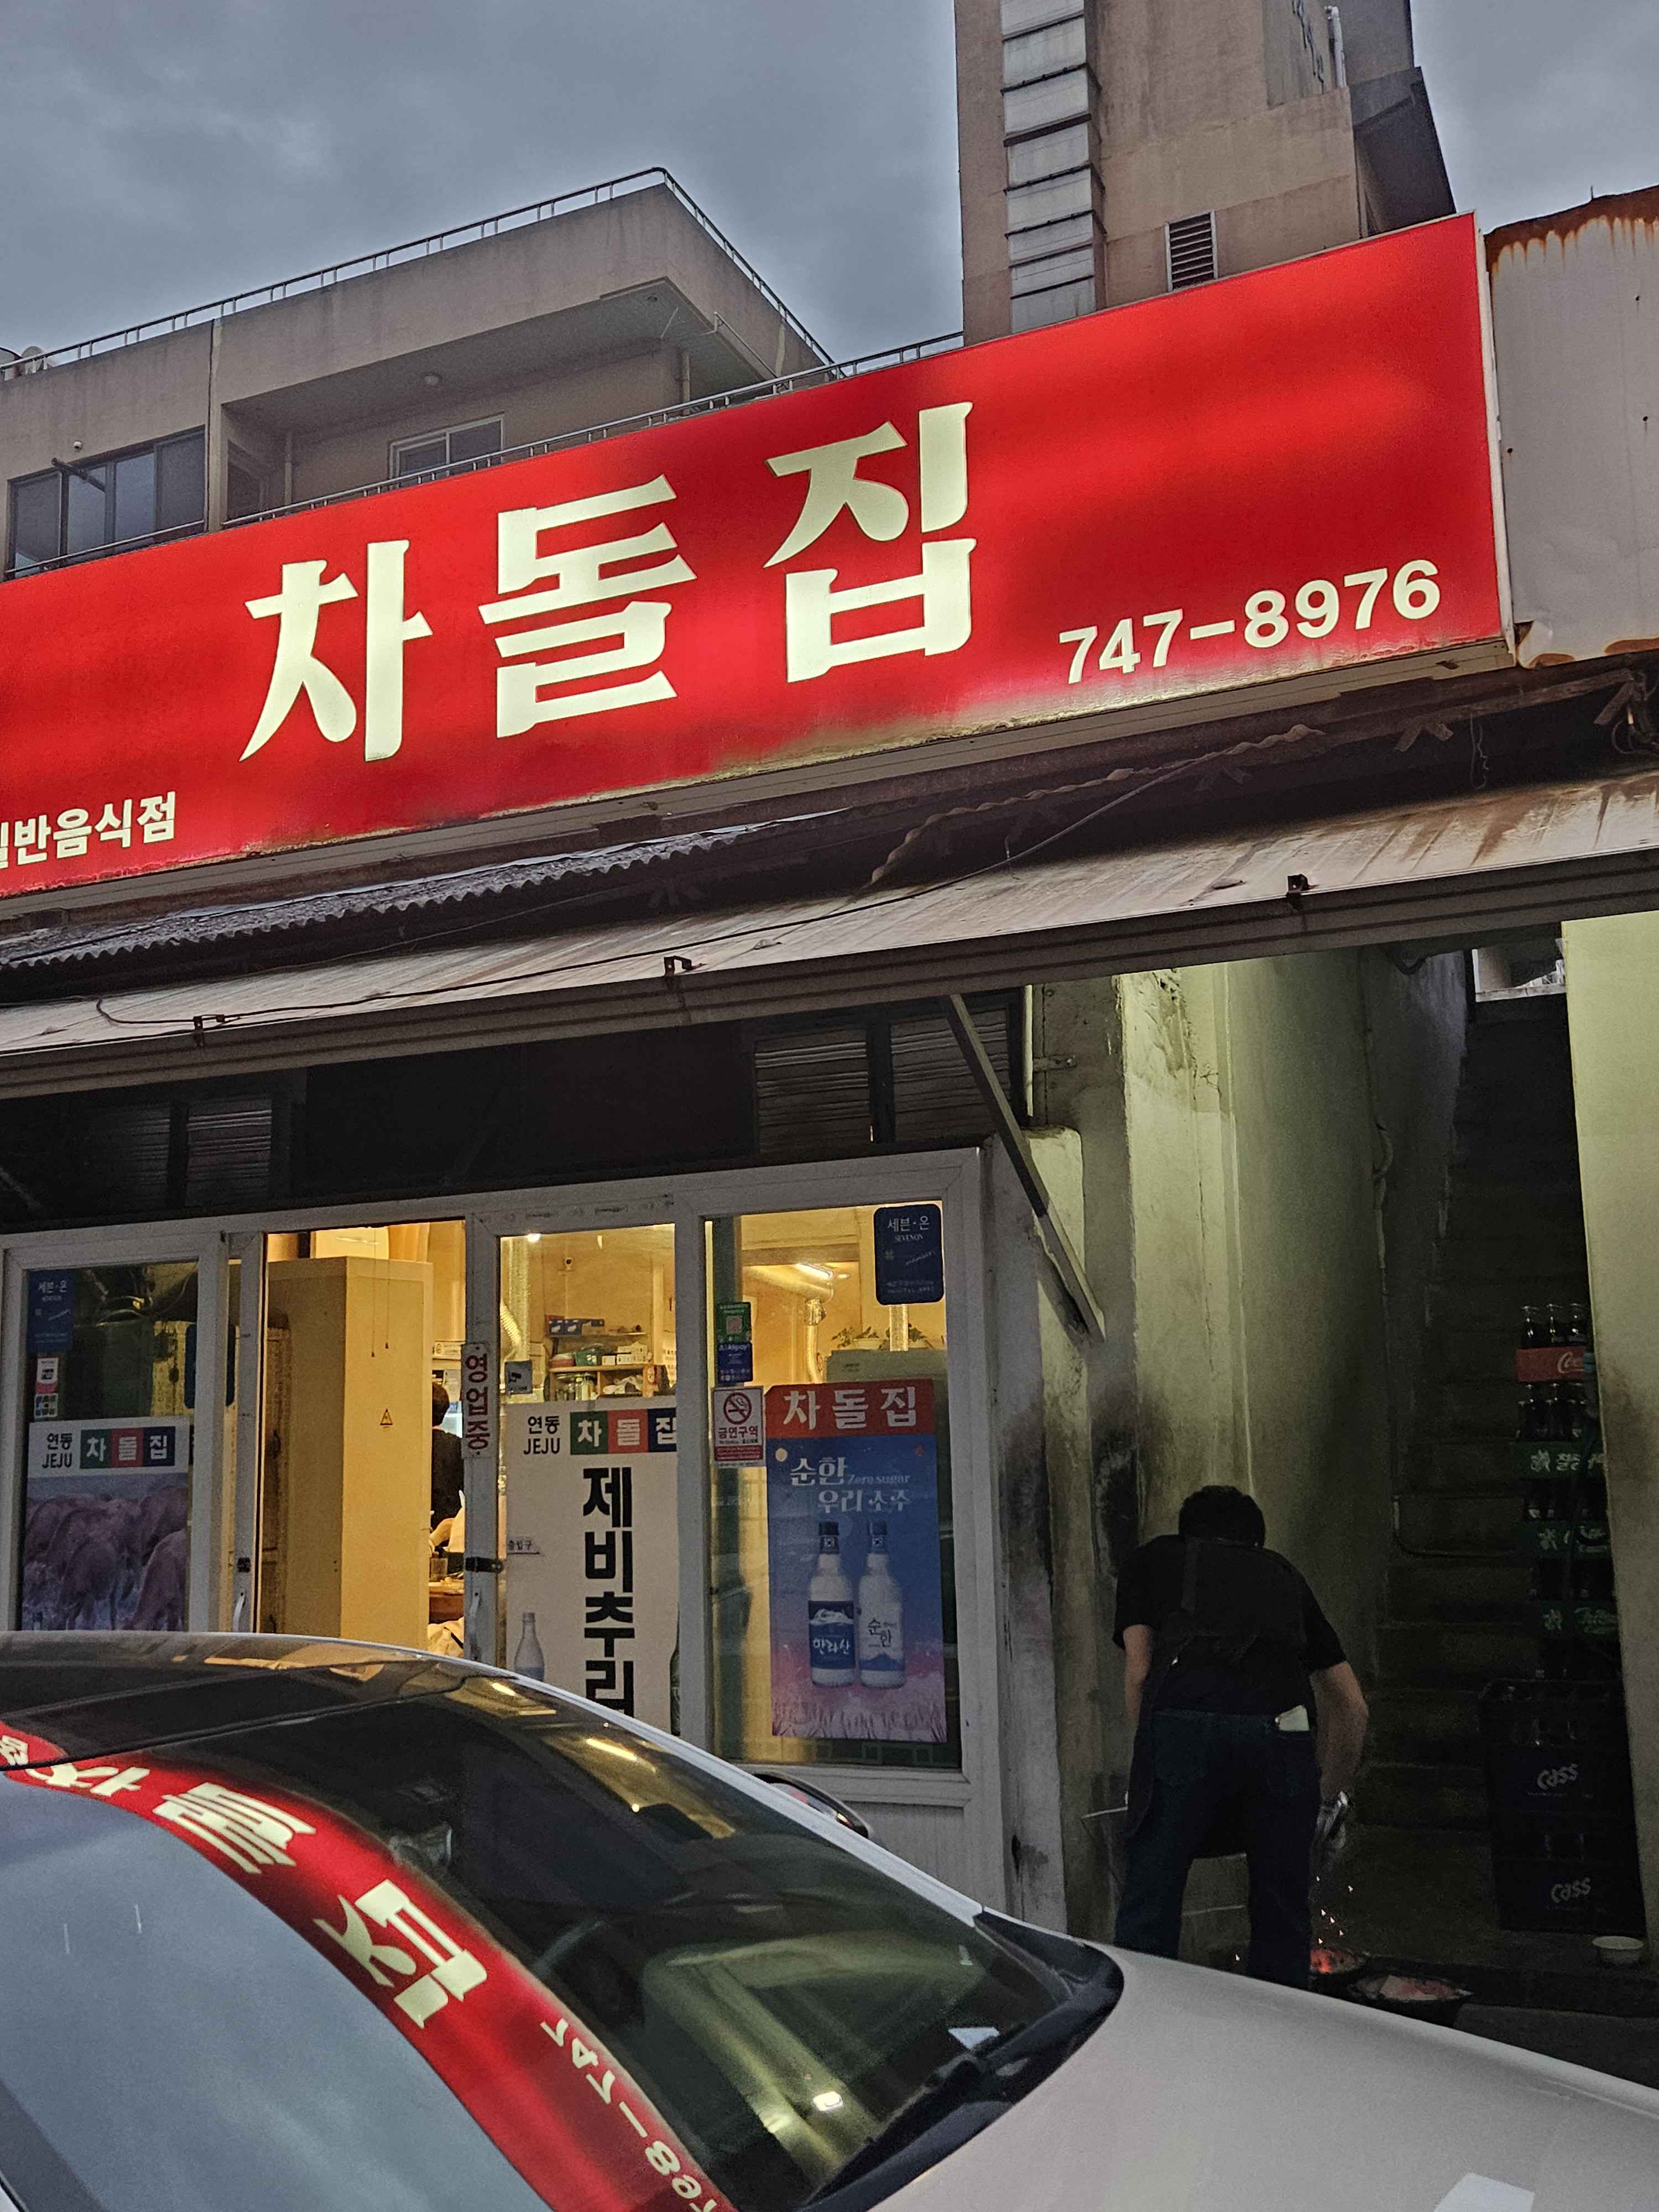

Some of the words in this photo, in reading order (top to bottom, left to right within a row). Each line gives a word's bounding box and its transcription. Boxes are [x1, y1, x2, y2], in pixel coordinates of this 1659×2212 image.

[239, 401, 977, 762] 차돌집
[1059, 559, 1441, 685] 747-8976
[465, 1350, 489, 1451] 영업중
[783, 1386, 917, 1430] 차돌집
[527, 1415, 560, 1435] 연동
[718, 1425, 758, 1438] 금연구역
[46, 1433, 72, 1450] 연동
[86, 1435, 168, 1462] 차돌집
[523, 1438, 561, 1455] JEJU
[42, 1453, 72, 1469] JEJU
[790, 1457, 848, 1486] 순한
[582, 1467, 635, 1719] 제비추리
